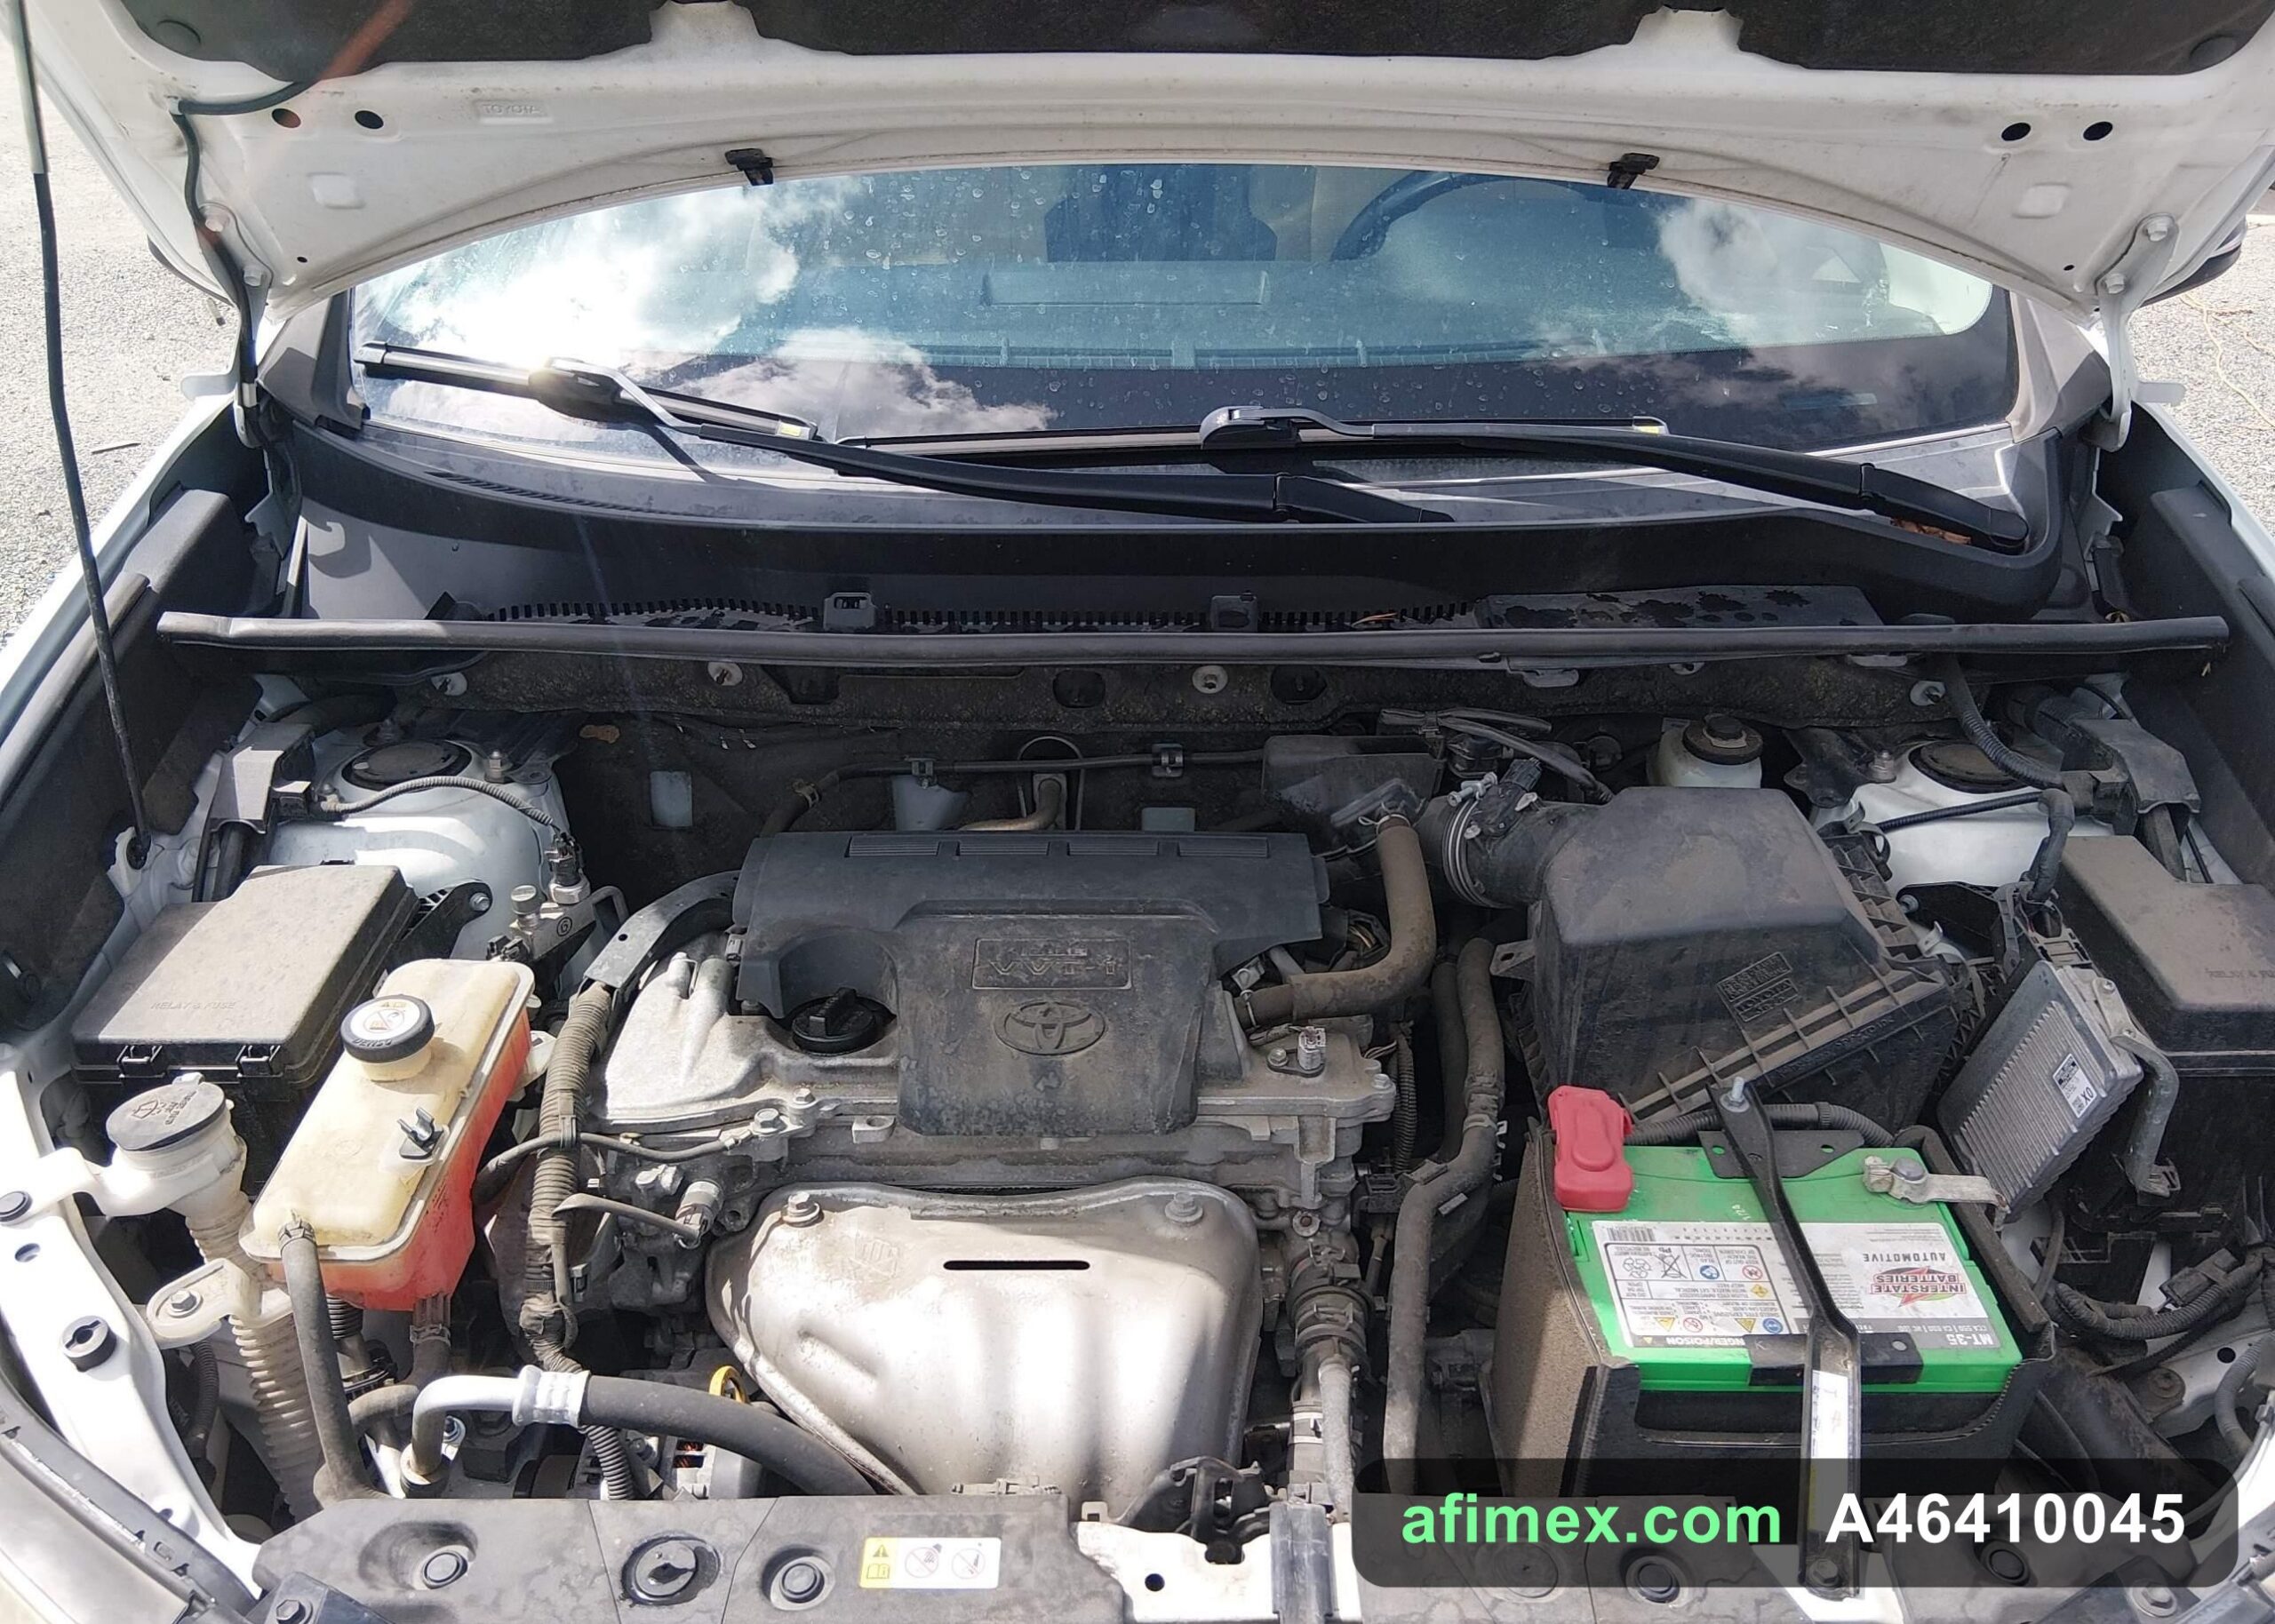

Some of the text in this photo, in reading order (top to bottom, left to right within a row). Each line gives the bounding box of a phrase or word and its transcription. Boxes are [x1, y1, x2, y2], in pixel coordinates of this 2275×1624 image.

[1863, 1252, 1945, 1262] AUTOMOTIVE
[1875, 1274, 1957, 1284] BATTERIES
[1874, 1285, 1965, 1294] INTERSTATE
[1665, 1336, 1745, 1346] NGER/POISON
[1946, 1333, 1993, 1345] MT-35
